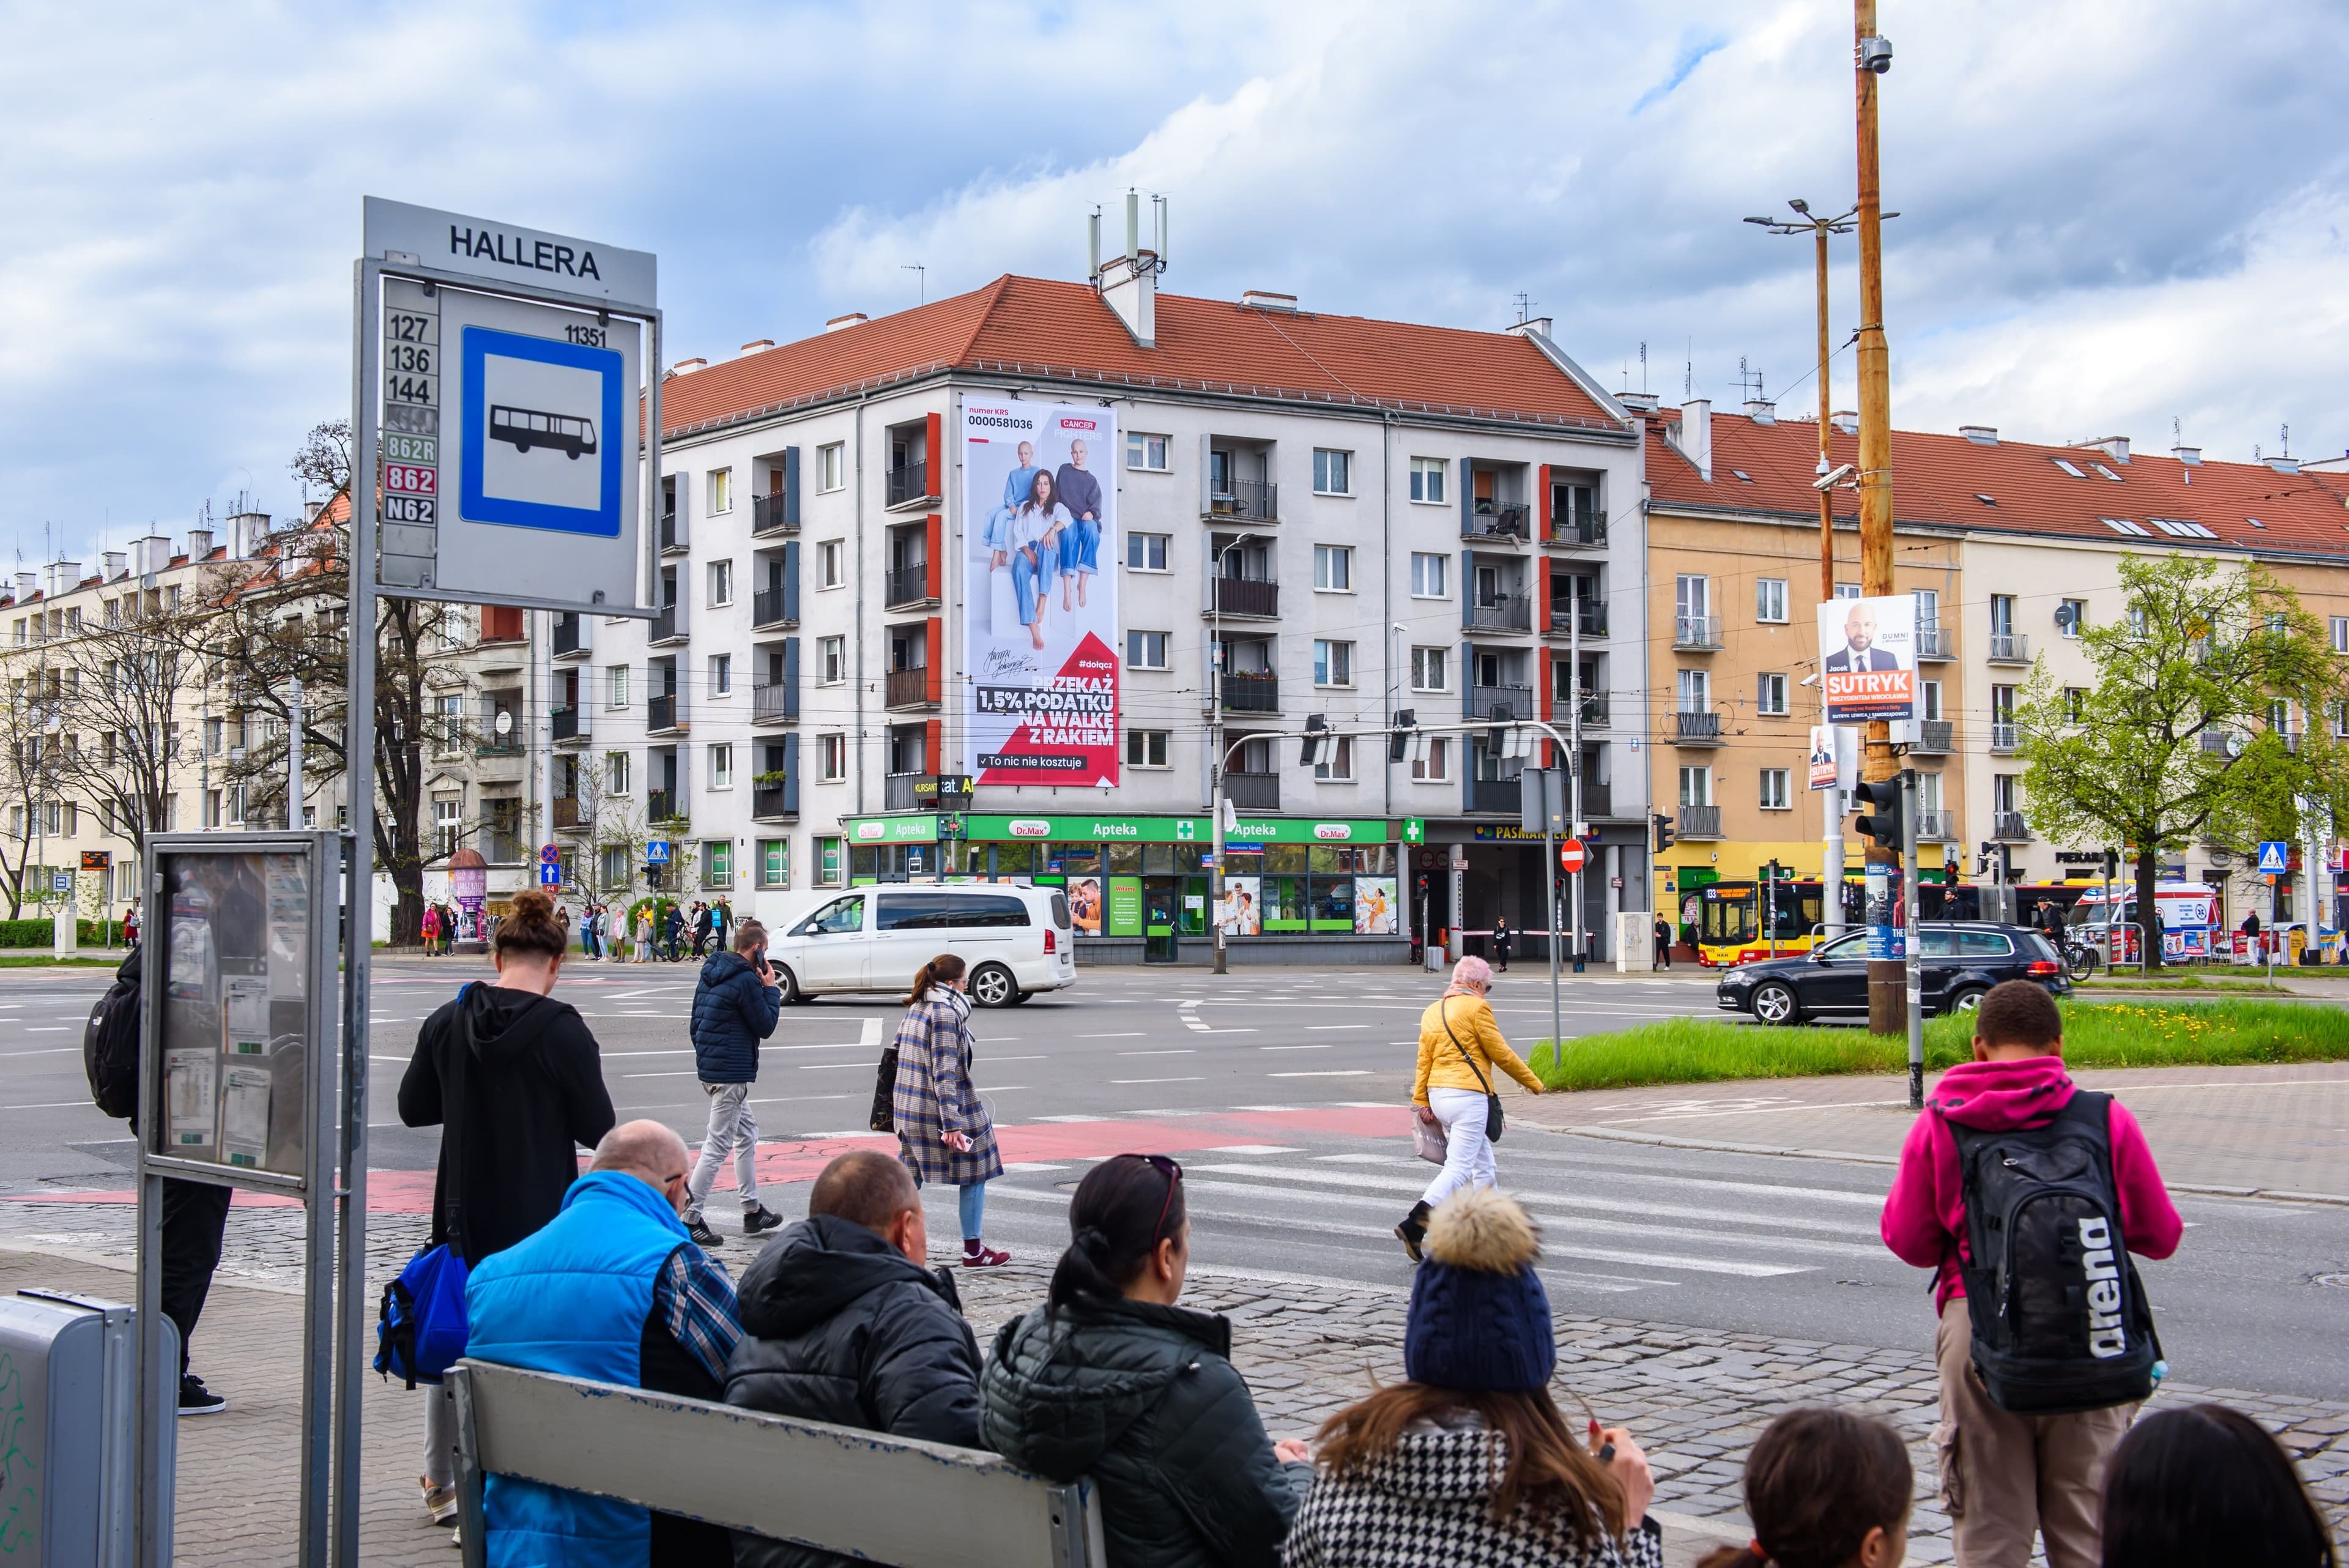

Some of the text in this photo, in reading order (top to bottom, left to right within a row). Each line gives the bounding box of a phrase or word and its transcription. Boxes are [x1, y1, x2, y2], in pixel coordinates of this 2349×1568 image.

[450, 225, 601, 281] HALLERA
[390, 314, 428, 341] 127
[565, 324, 607, 348] 11351
[390, 344, 431, 373] 136
[388, 374, 430, 404] 144
[968, 415, 1033, 429] 0000581036
[1063, 420, 1093, 429] CANCER
[1053, 429, 1102, 441] FIGHTERS
[388, 436, 435, 461] 862R
[388, 466, 434, 492] 862
[387, 497, 432, 523] N62
[1078, 660, 1113, 669] #dołącz
[1031, 674, 1114, 694] PRZEKAŻ
[1828, 673, 1909, 694] SUTRYK
[979, 690, 1113, 712] 1,5% PODATKU
[1018, 710, 1114, 730] NA WALKĘ
[1030, 728, 1114, 746] Z RAKIEM
[989, 756, 1082, 770] To nic nie kosztuje
[1812, 763, 1835, 776] SUTRYK
[915, 782, 938, 793] KURSANT
[896, 822, 926, 838] Apteka
[1017, 822, 1277, 838] Dr.Max Apteka Apteka
[1706, 889, 1716, 899] 133
[1891, 928, 1904, 938] THE
[2077, 1217, 2126, 1358] arena
